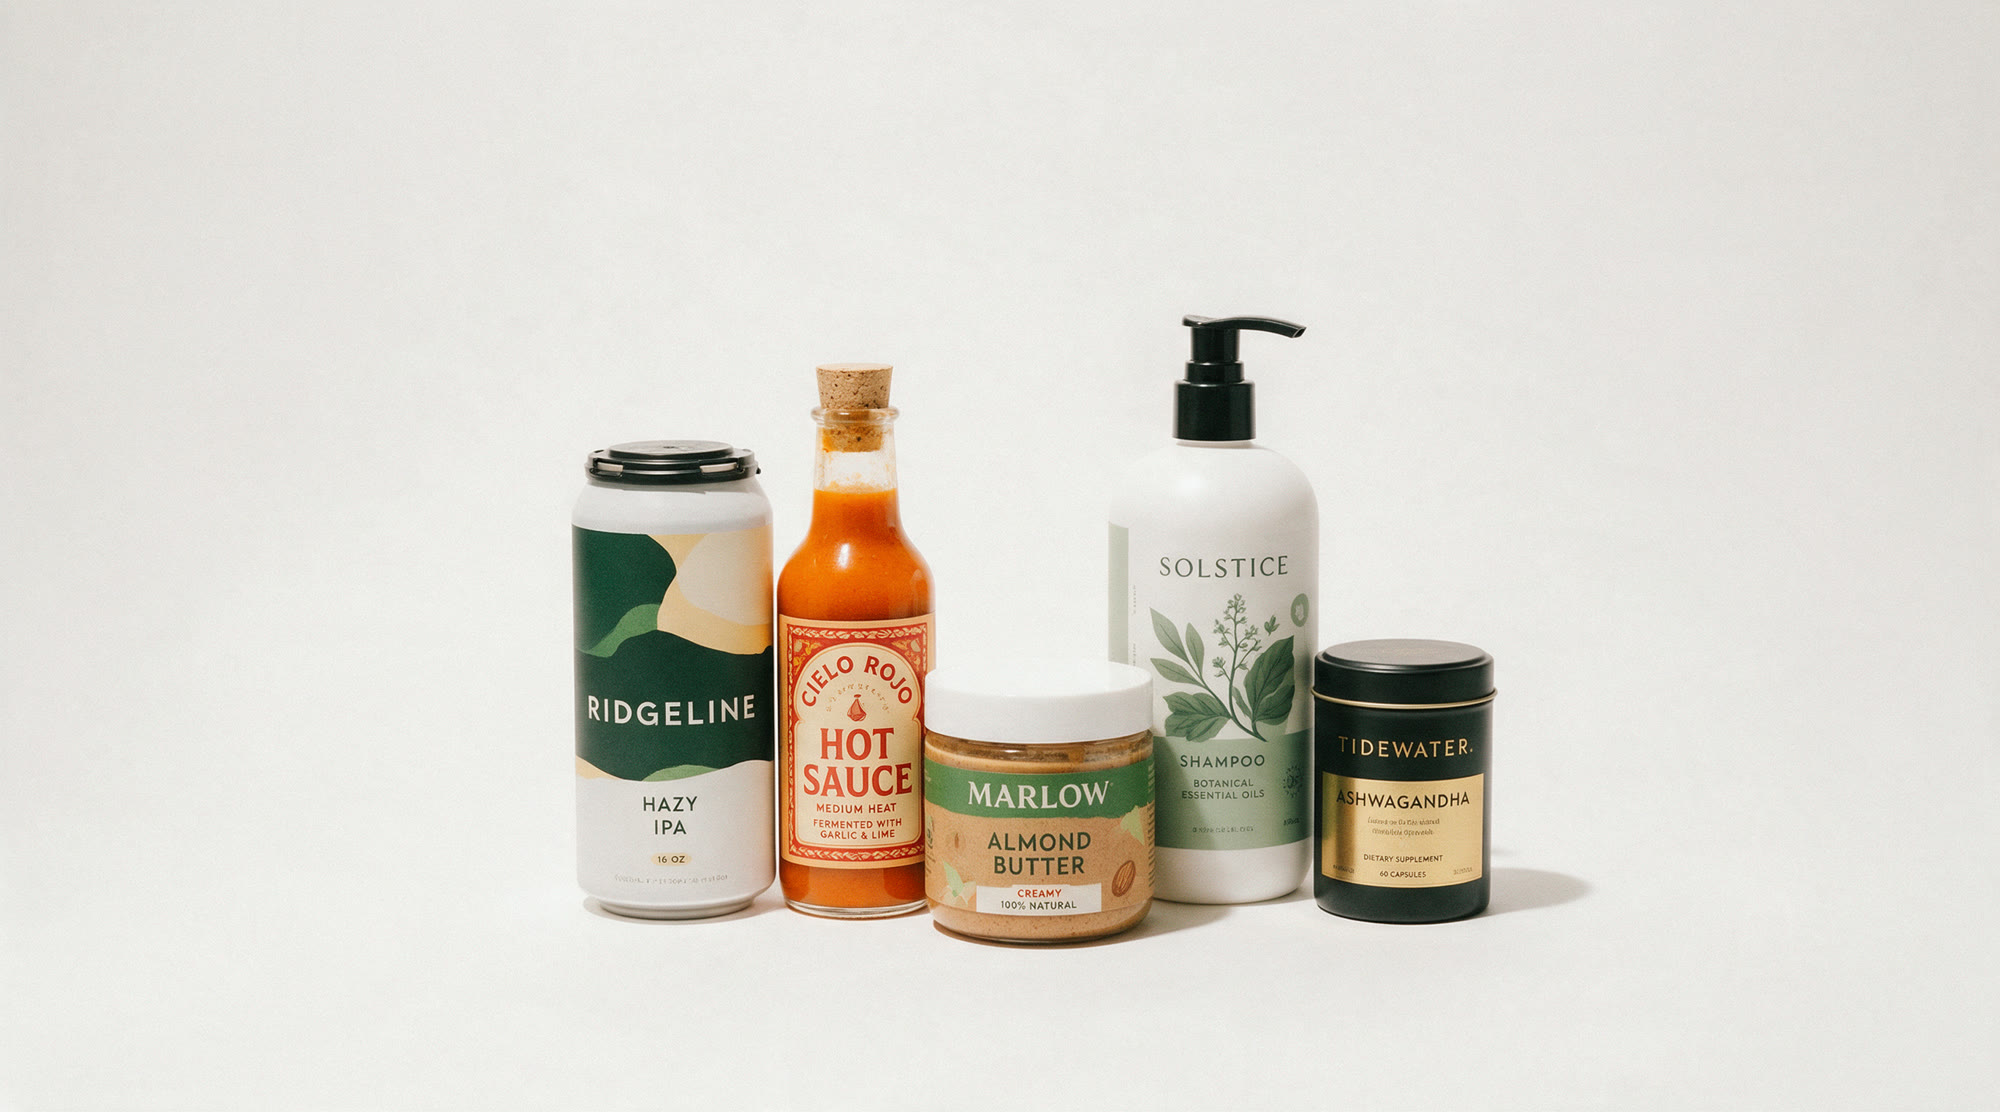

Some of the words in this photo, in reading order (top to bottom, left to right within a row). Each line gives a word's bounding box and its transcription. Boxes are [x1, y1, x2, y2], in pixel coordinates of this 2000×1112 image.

[1159, 555, 1289, 578] SOLSTICE
[801, 655, 854, 707] CIELO
[863, 655, 913, 704] ROJO
[587, 694, 756, 726] RIDGELINE
[820, 727, 894, 760] HOT
[1180, 754, 1266, 769] SHAMPOO
[803, 762, 913, 798] SAUCE
[1193, 778, 1254, 788] BOTANICAL
[967, 780, 1110, 809] MARLOW
[1181, 789, 1238, 800] ESSENTIAL
[1241, 789, 1265, 799] OILS
[1336, 788, 1470, 809] ASHWAGANDHA
[643, 796, 698, 812] HAZY
[816, 803, 863, 814] MEDIUM
[868, 802, 897, 813] HEAT
[654, 819, 687, 836] IPA
[813, 818, 873, 829] FERMENTED
[876, 818, 902, 828] WITH
[820, 830, 857, 840] GARLIC
[860, 831, 868, 840] &
[871, 829, 895, 839] LIME
[987, 831, 1091, 852] ALMOND
[657, 855, 668, 864] 16
[671, 855, 686, 864] OZ
[993, 855, 1085, 876] BUTTER
[1363, 853, 1394, 863] DIETARY
[1395, 854, 1443, 863] SUPPLEMENT
[1379, 870, 1389, 878] 60
[1390, 870, 1427, 878] CAPSULES
[1017, 888, 1062, 898] CREAMY
[1000, 900, 1026, 910] 100%
[1029, 900, 1077, 910] NATURAL
